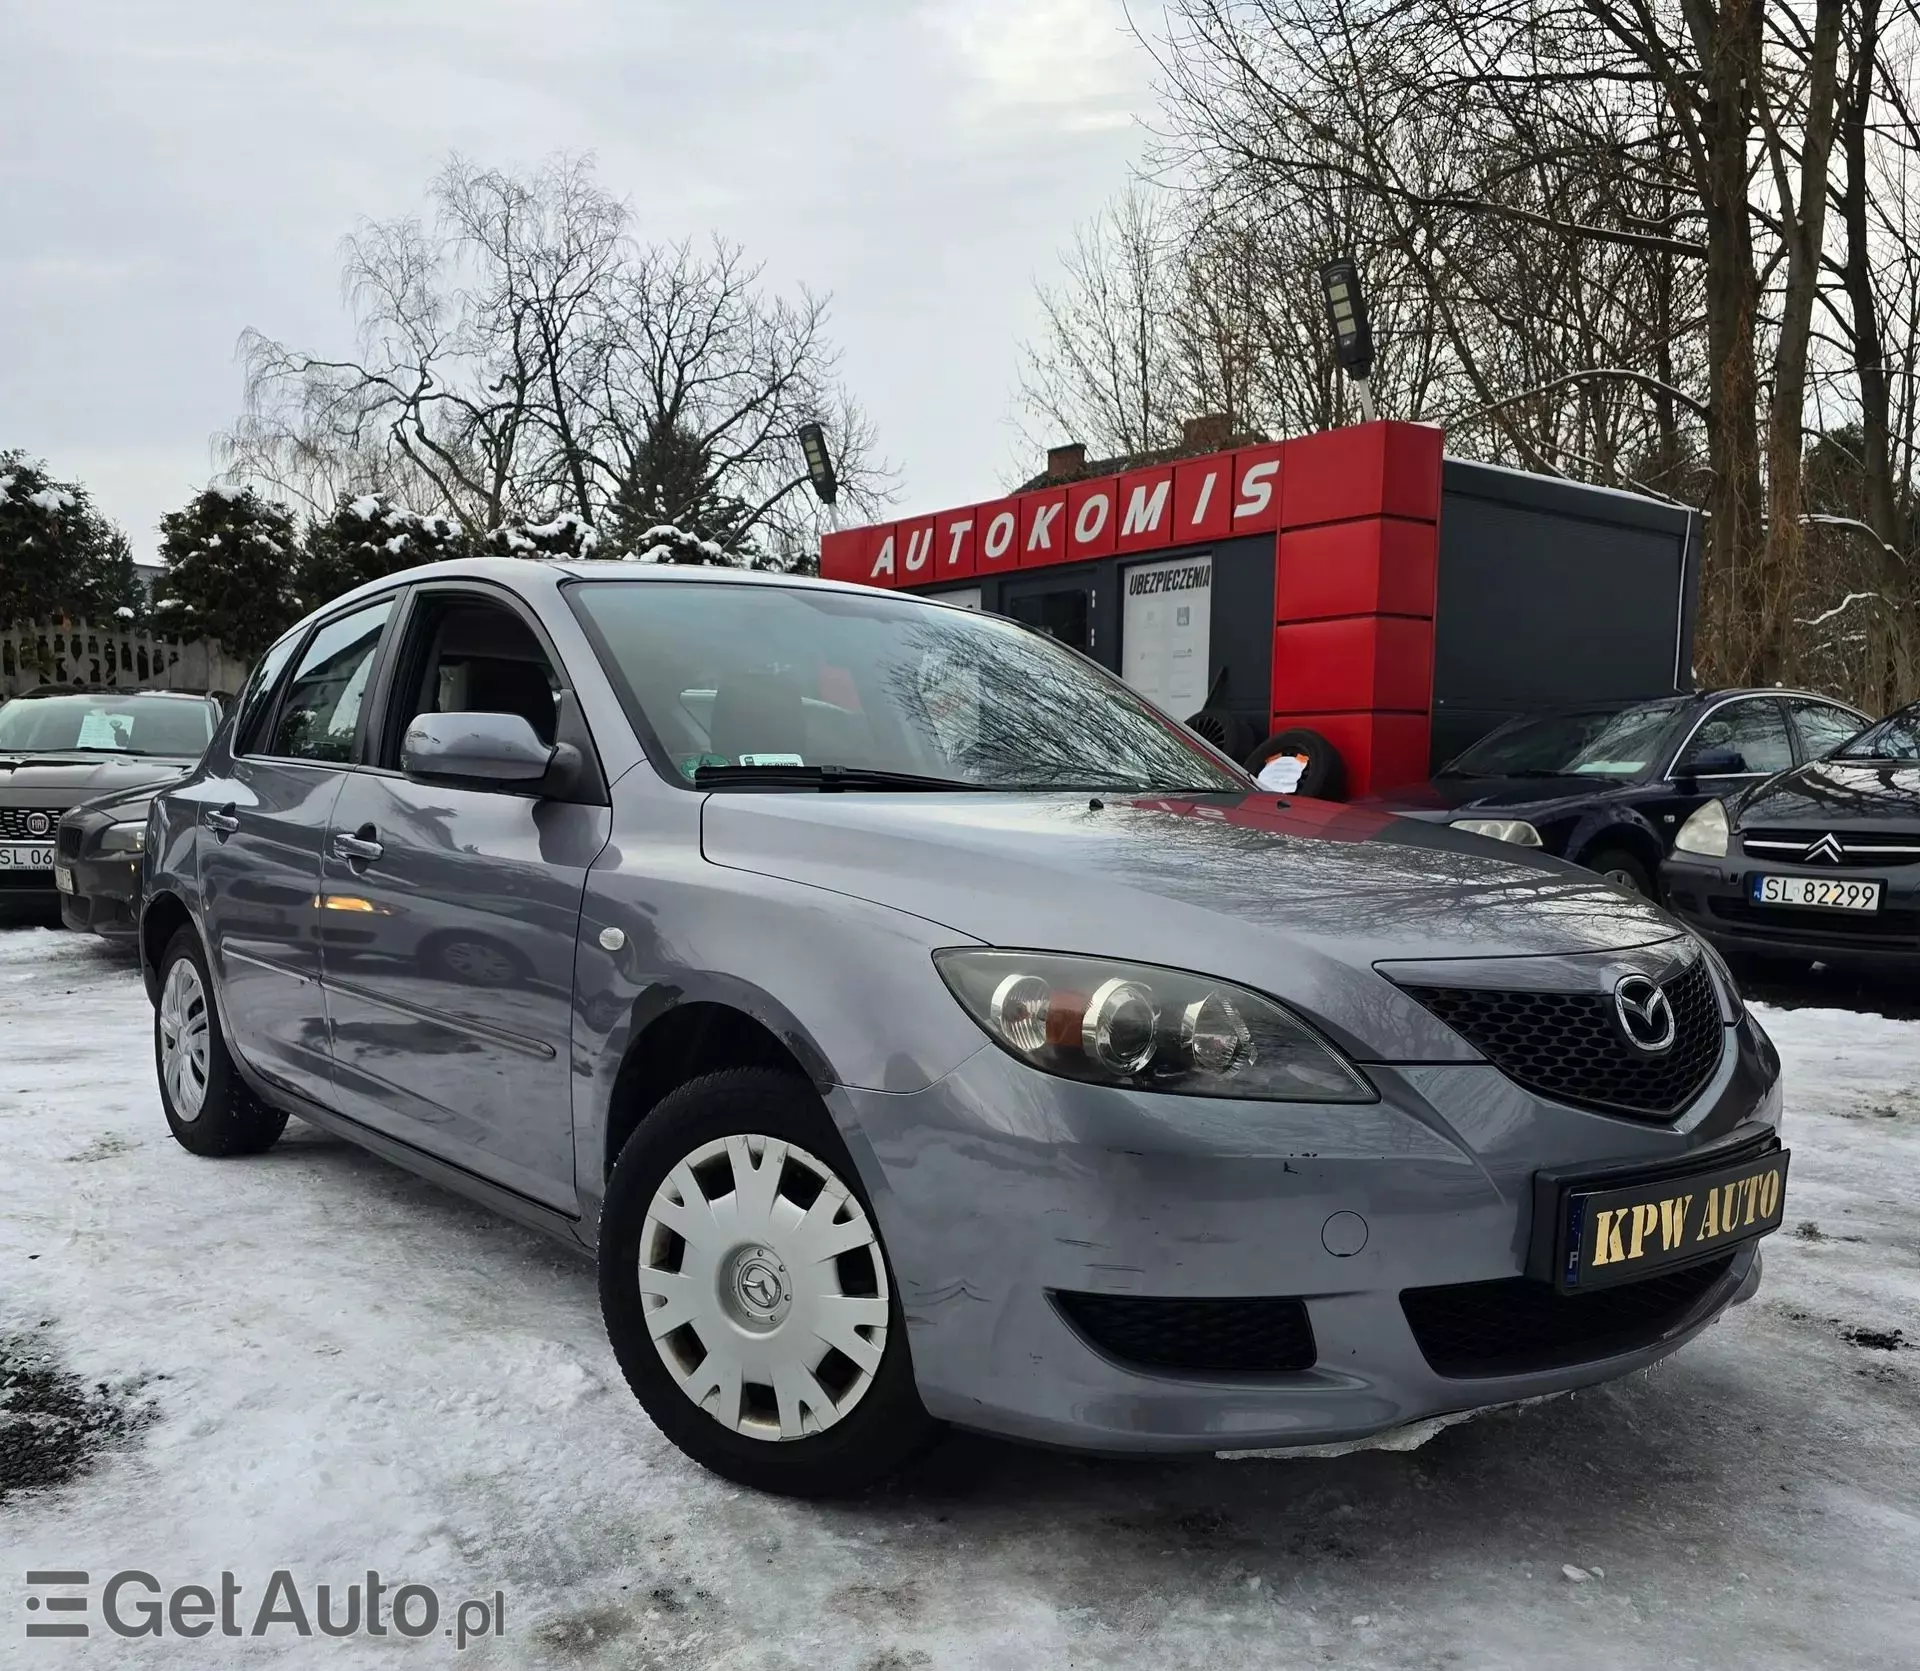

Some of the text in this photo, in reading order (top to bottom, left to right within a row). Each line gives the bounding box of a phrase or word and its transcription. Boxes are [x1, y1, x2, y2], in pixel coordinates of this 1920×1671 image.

[869, 459, 1281, 578] AUTOKOMIS
[1129, 564, 1211, 596] UBEZPIECZENIA
[0, 849, 24, 865] SL
[1765, 879, 1875, 908] SL 82299
[1592, 1169, 1780, 1266] KPW AUTO
